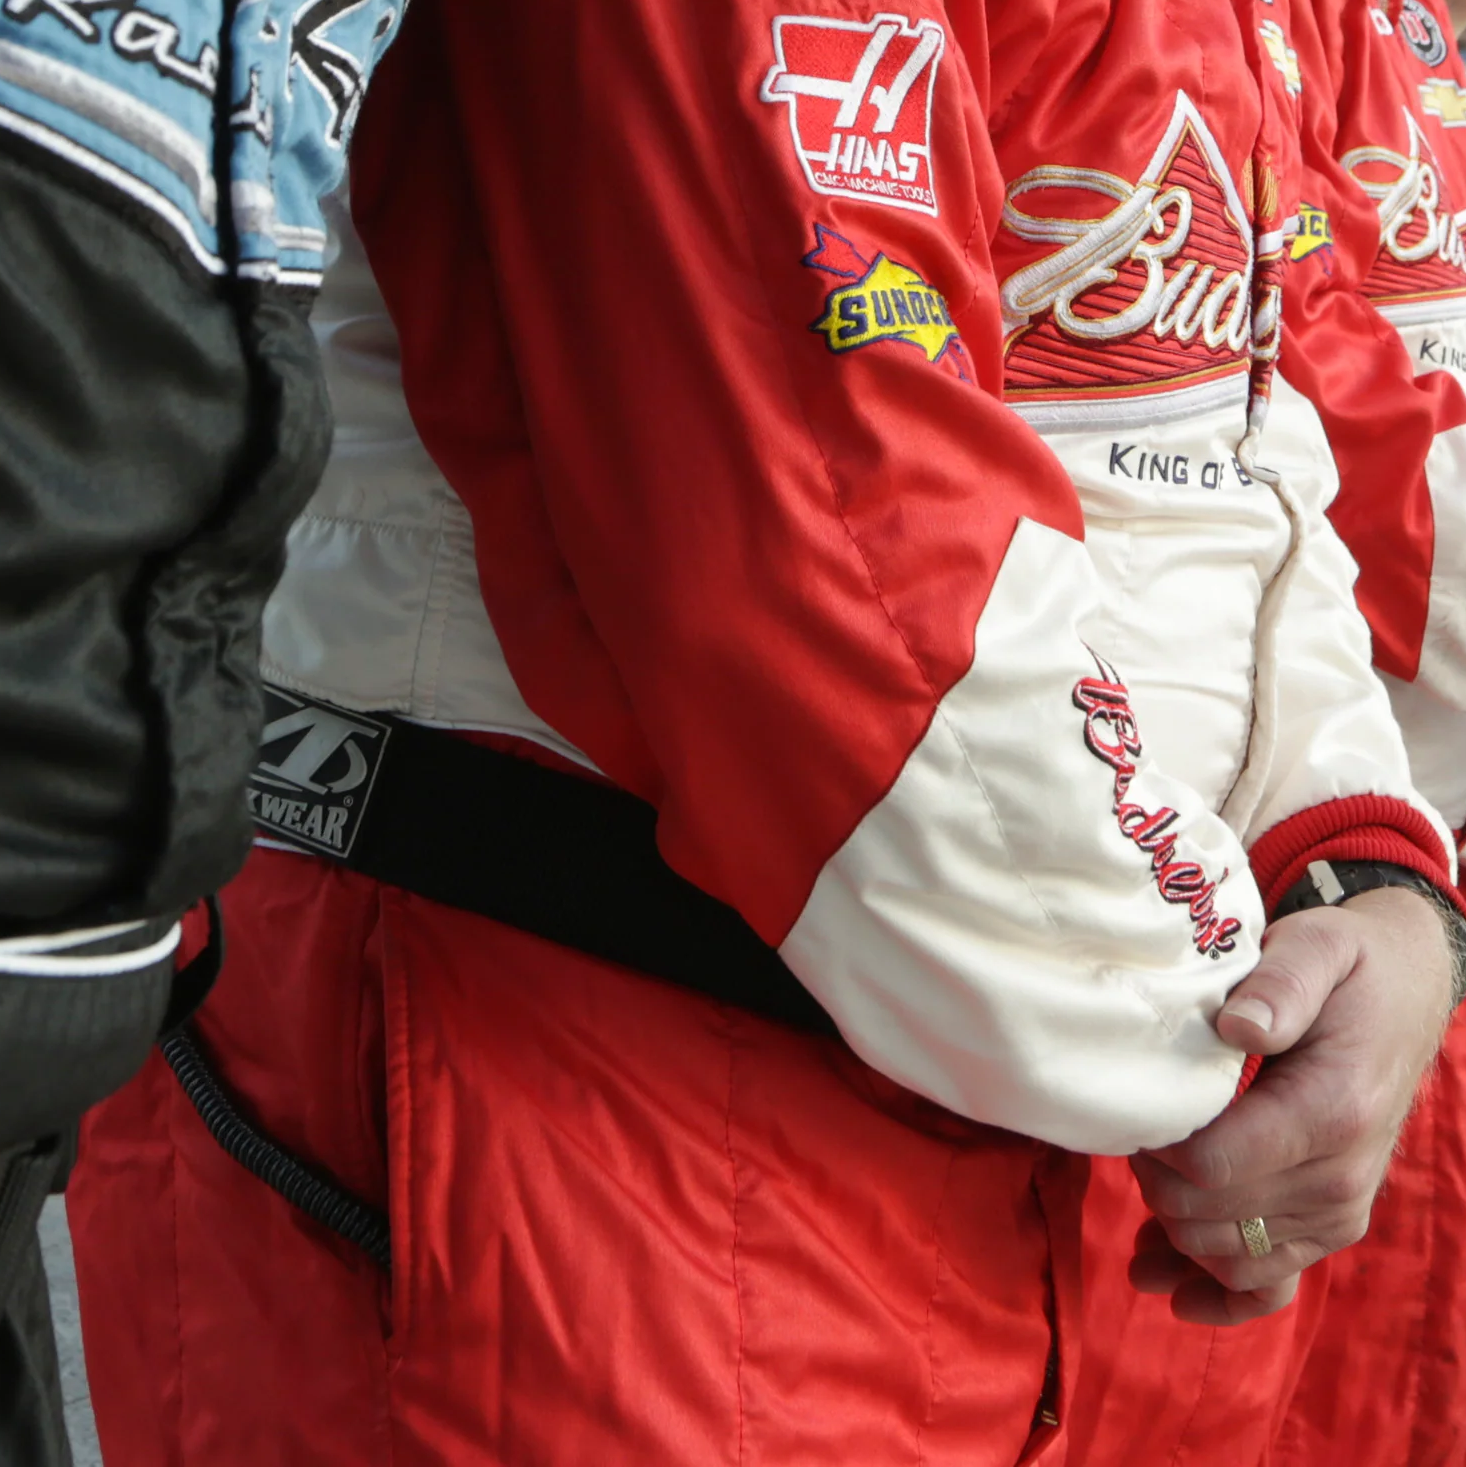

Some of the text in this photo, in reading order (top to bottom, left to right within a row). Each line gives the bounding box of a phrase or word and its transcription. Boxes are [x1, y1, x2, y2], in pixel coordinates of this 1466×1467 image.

[823, 132, 928, 183] HAAS
[814, 171, 933, 205] CNC MACHINE TOOLS
[1108, 442, 1189, 486] KING
